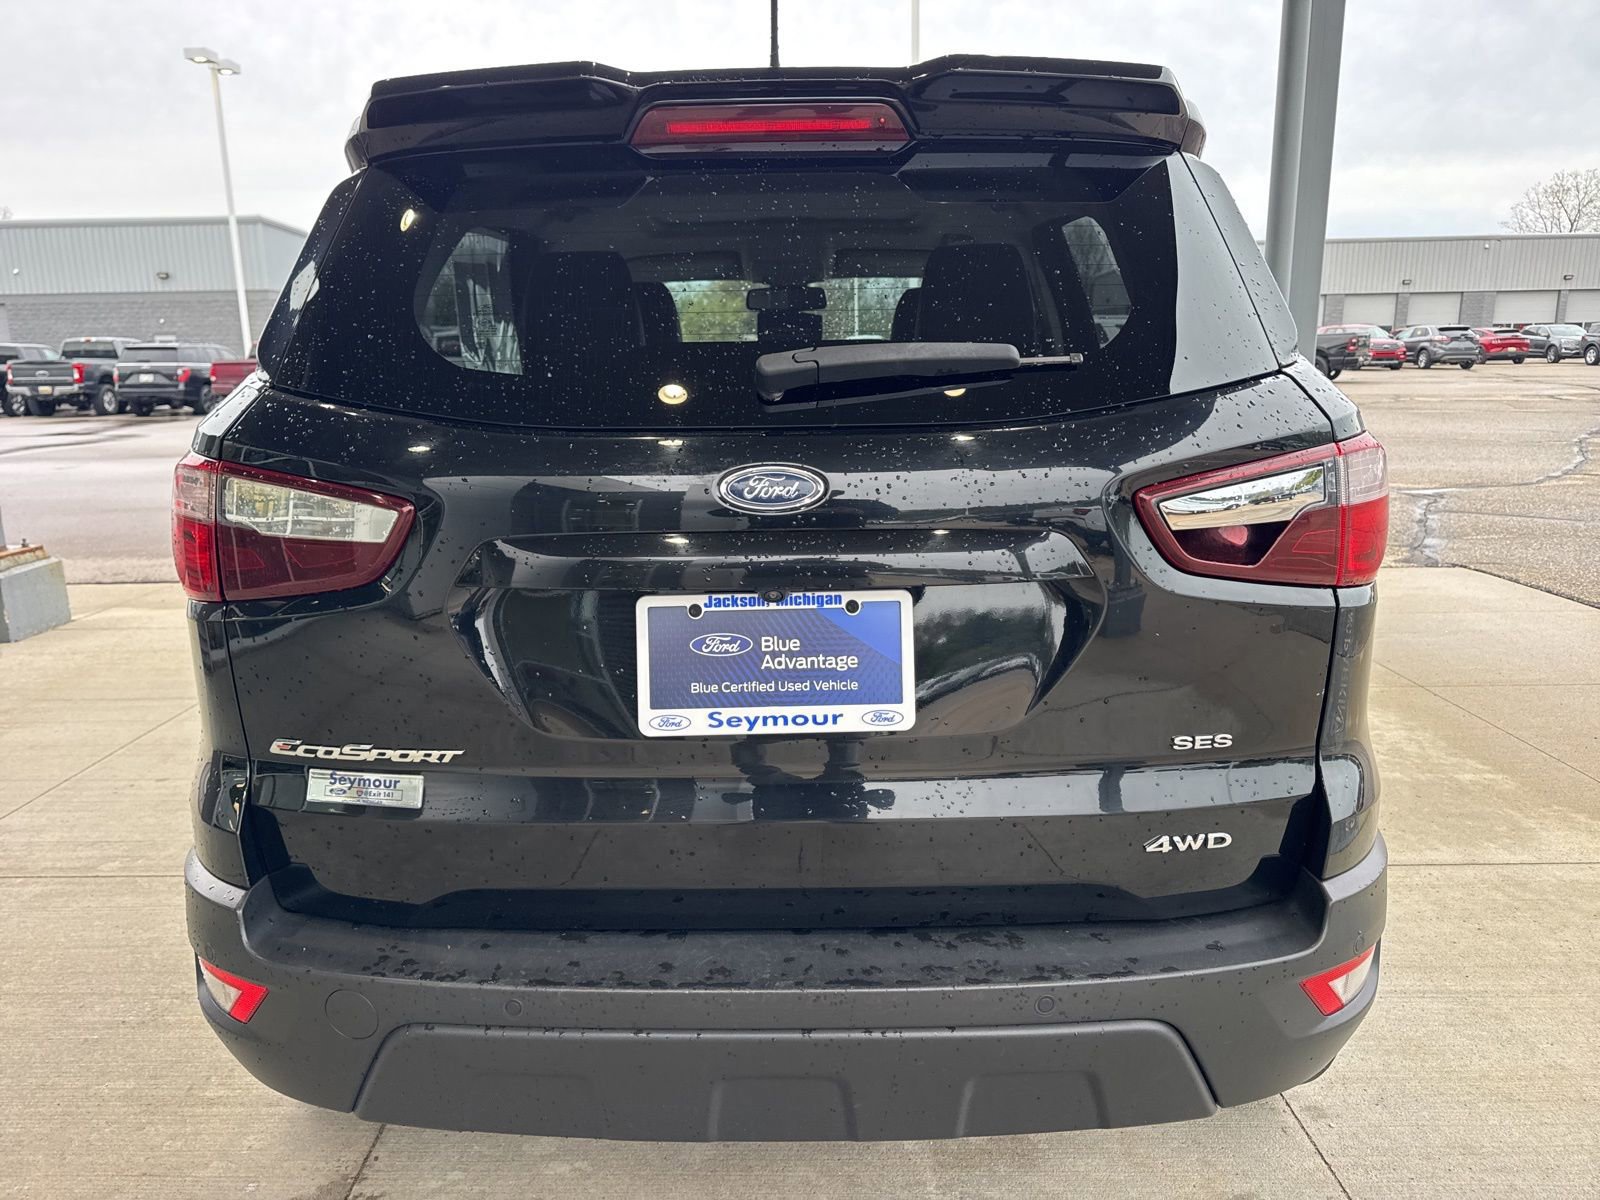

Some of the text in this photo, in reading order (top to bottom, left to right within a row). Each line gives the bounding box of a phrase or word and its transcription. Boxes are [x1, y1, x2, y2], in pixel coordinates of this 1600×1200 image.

[743, 475, 800, 499] Ford
[702, 636, 800, 653] Ford Blue
[761, 654, 859, 671] Advantage
[690, 679, 859, 693] Blue Certified Used Vehicle
[657, 711, 896, 731] Ford Seymour Ford
[1172, 733, 1233, 750] SES
[329, 771, 401, 790] Seymour
[1143, 832, 1233, 853] 4WD
